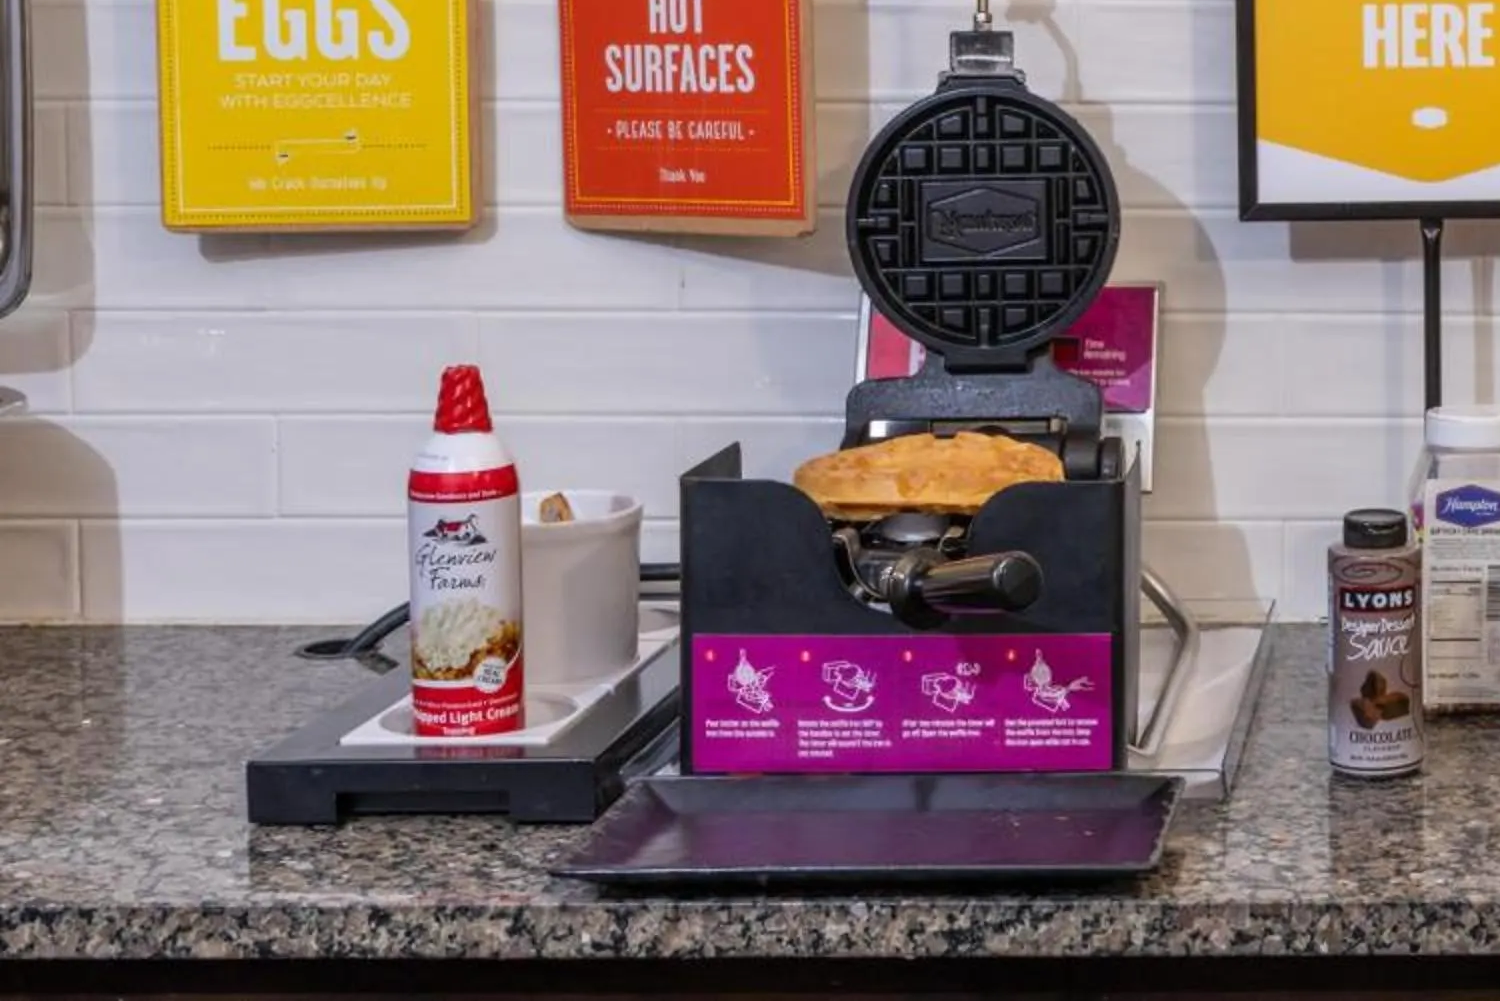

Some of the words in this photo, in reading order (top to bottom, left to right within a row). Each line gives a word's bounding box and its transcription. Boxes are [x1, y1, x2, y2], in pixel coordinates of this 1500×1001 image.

[1362, 2, 1495, 68] HERE
[605, 43, 755, 93] SURFACES
[235, 73, 293, 89] START
[299, 73, 350, 88] YOUR
[356, 73, 391, 88] DAY
[220, 93, 269, 109] WITH
[273, 92, 412, 109] EGGCELLENCE
[615, 120, 663, 140] PLEASE
[667, 120, 683, 140] BE
[687, 120, 745, 141] CAREFUL
[659, 167, 687, 183] Thank
[1440, 495, 1499, 515] Hampton
[416, 541, 497, 579] Glenview
[429, 566, 483, 590] Farms
[1344, 590, 1413, 609] LYONS
[1346, 633, 1410, 662] Sauce
[449, 710, 483, 726] Light
